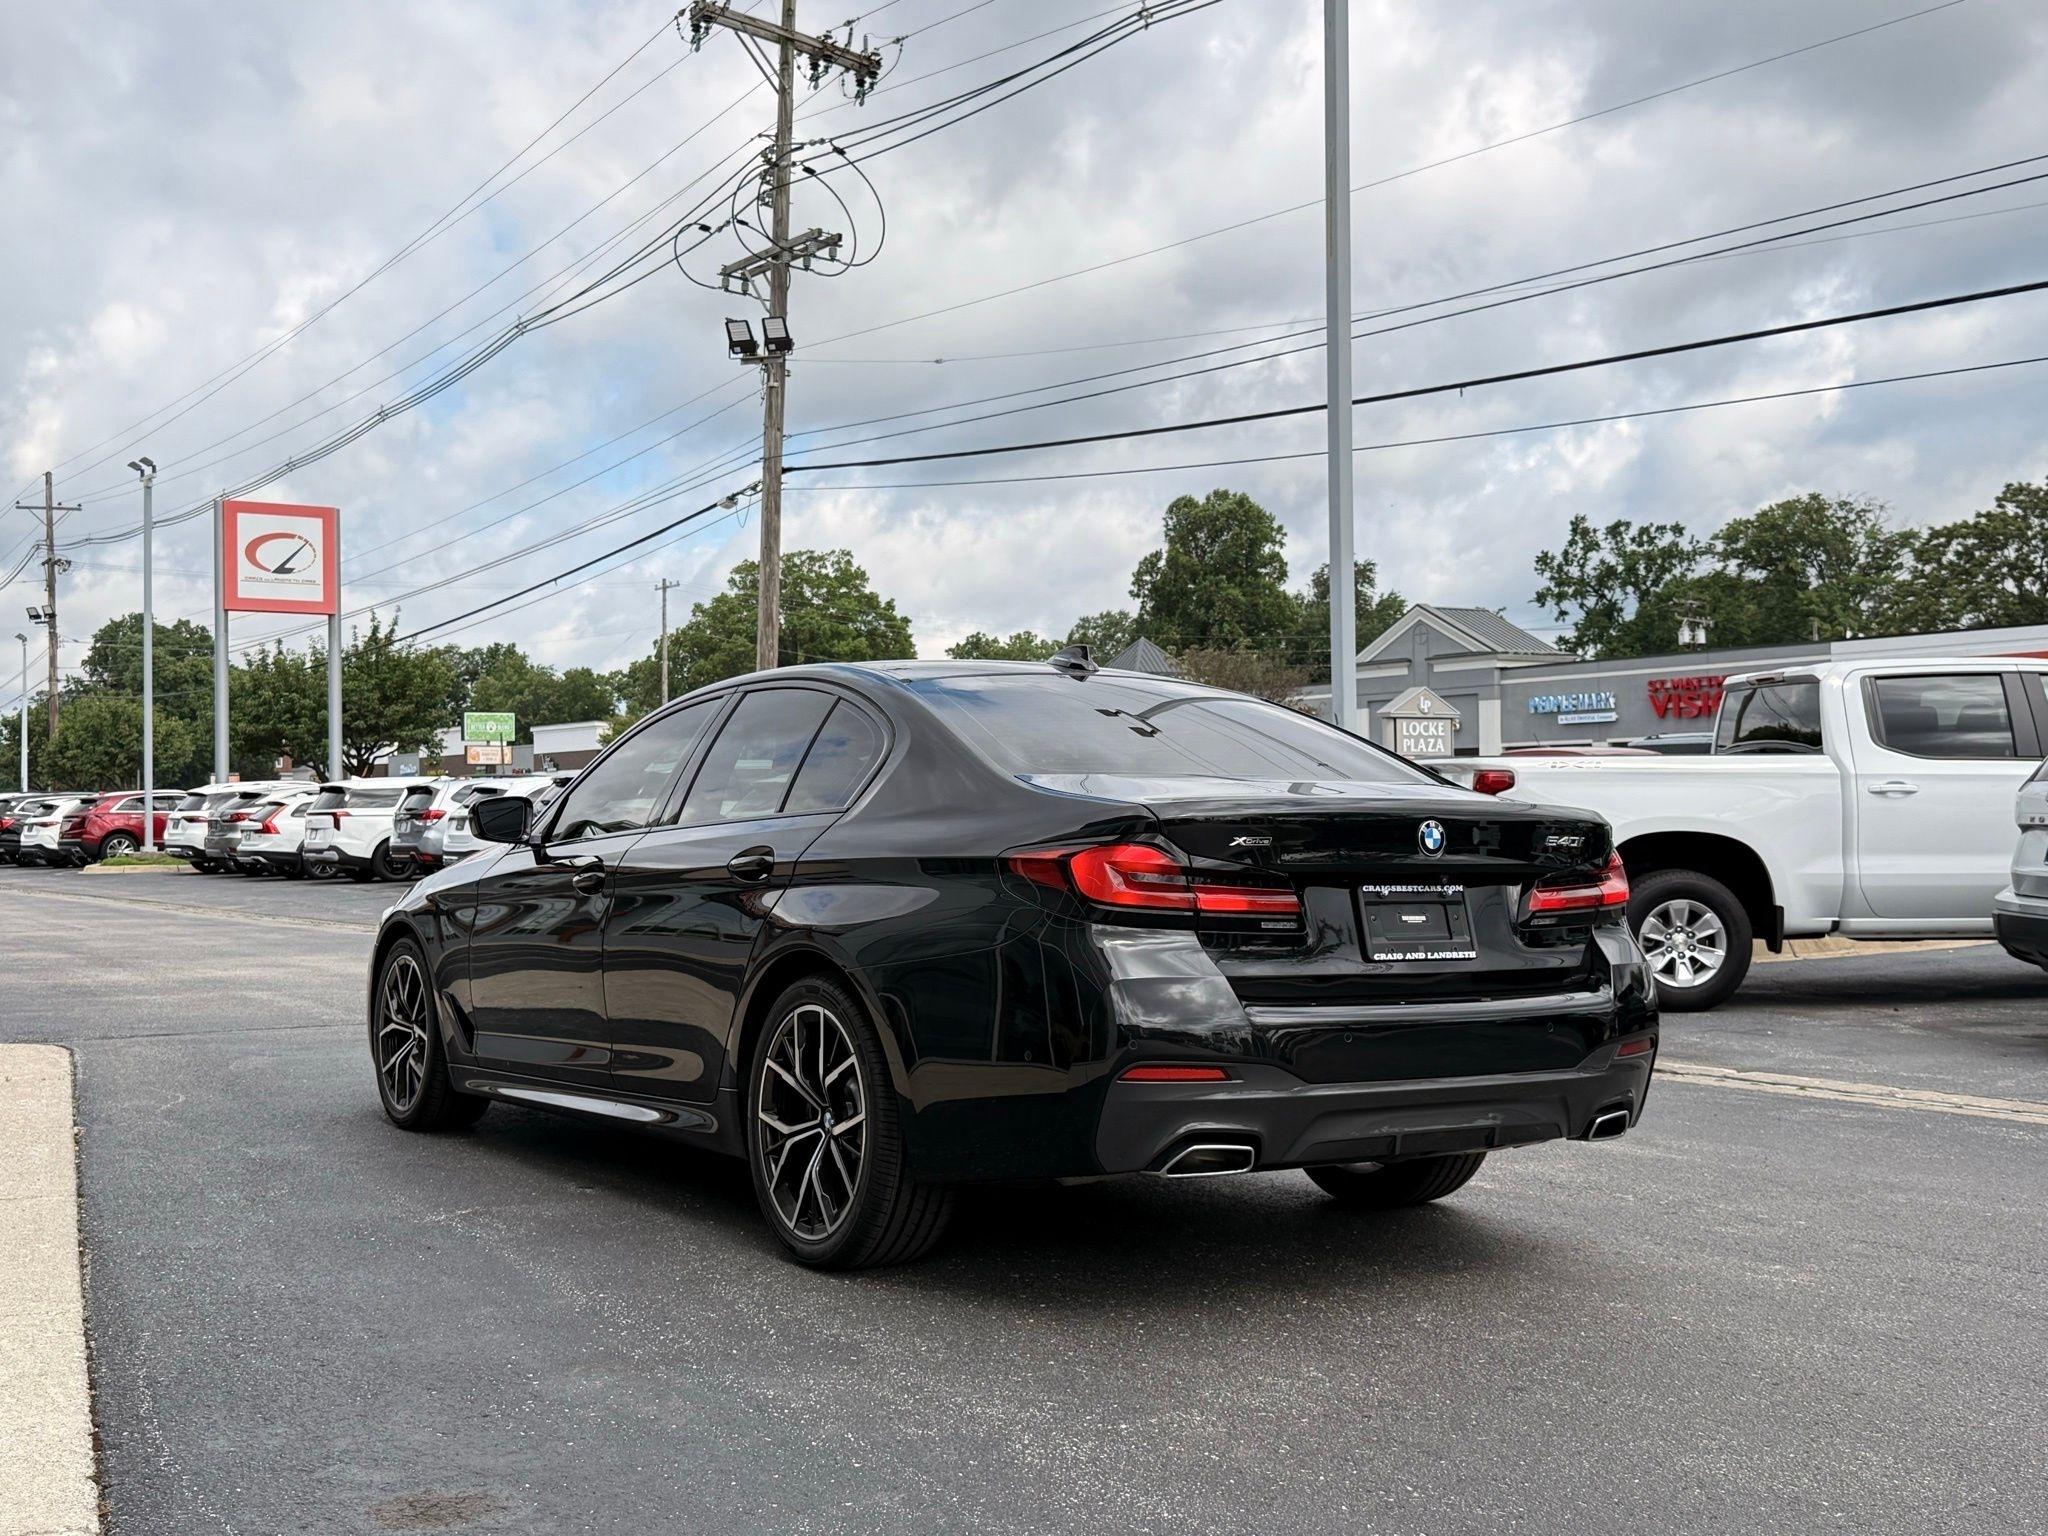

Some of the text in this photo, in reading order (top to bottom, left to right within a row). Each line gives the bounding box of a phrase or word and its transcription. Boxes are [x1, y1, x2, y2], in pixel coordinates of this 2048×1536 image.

[1402, 721, 1445, 736] LOCKE
[1403, 738, 1445, 752] PLAZA
[1373, 951, 1477, 961] CRAIG AND LANDRETH
